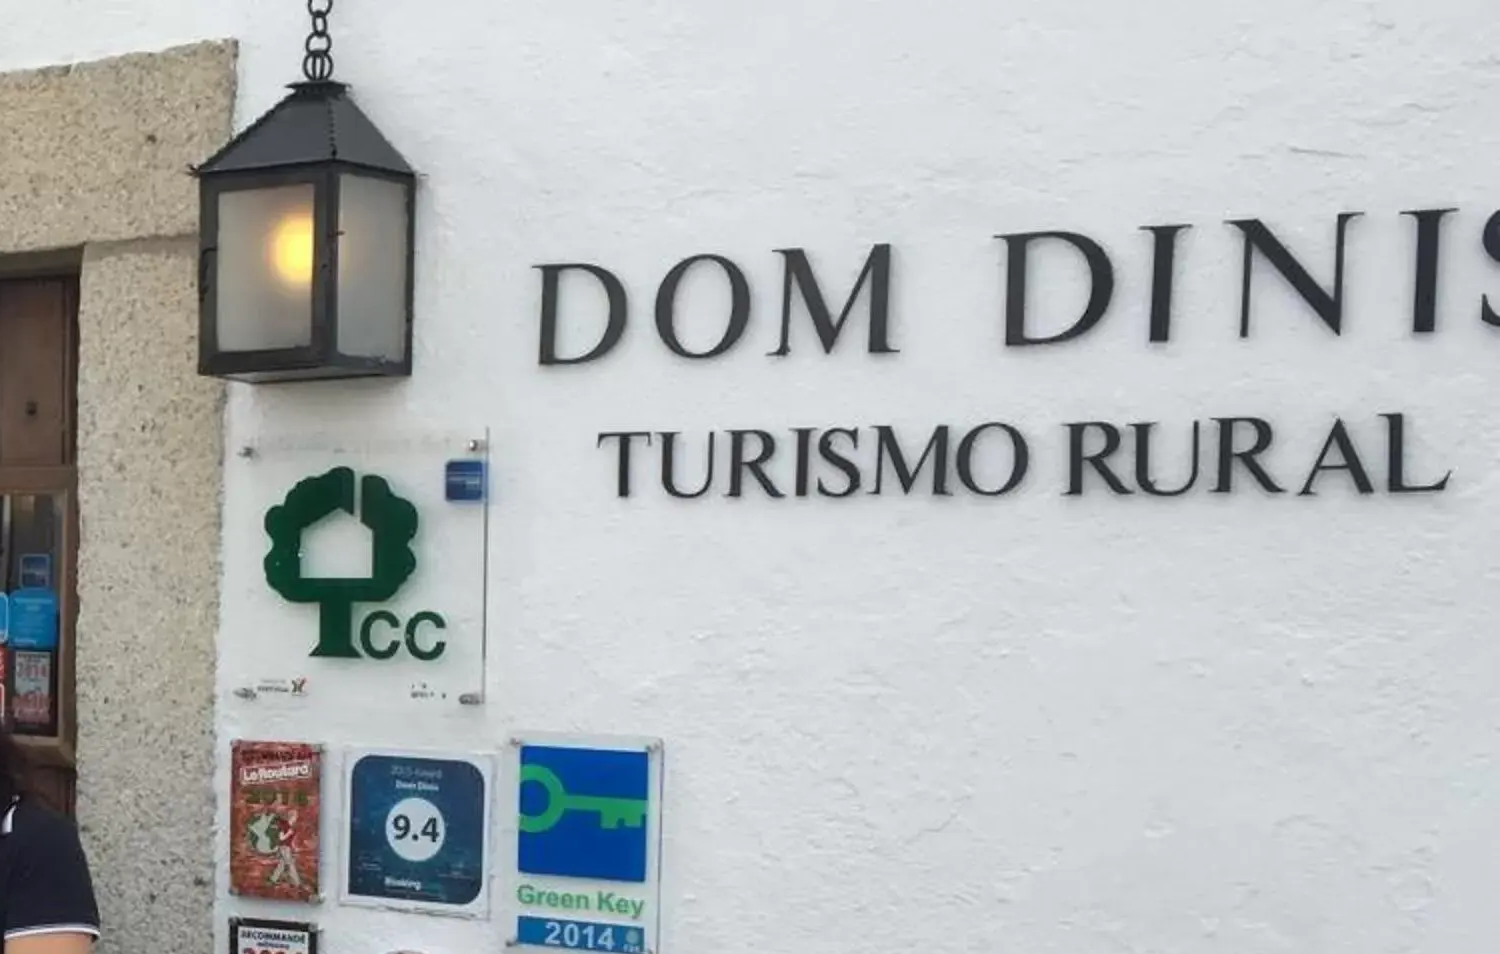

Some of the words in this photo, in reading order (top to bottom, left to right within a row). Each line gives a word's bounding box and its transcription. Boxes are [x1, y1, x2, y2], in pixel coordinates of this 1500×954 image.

[531, 243, 900, 366] DOM
[597, 422, 1030, 499] TURISMO
[1061, 412, 1453, 496] RURAL
[392, 814, 440, 843] 9.4
[517, 884, 590, 910] Green
[597, 891, 645, 919] Key
[544, 921, 615, 950] 2014
